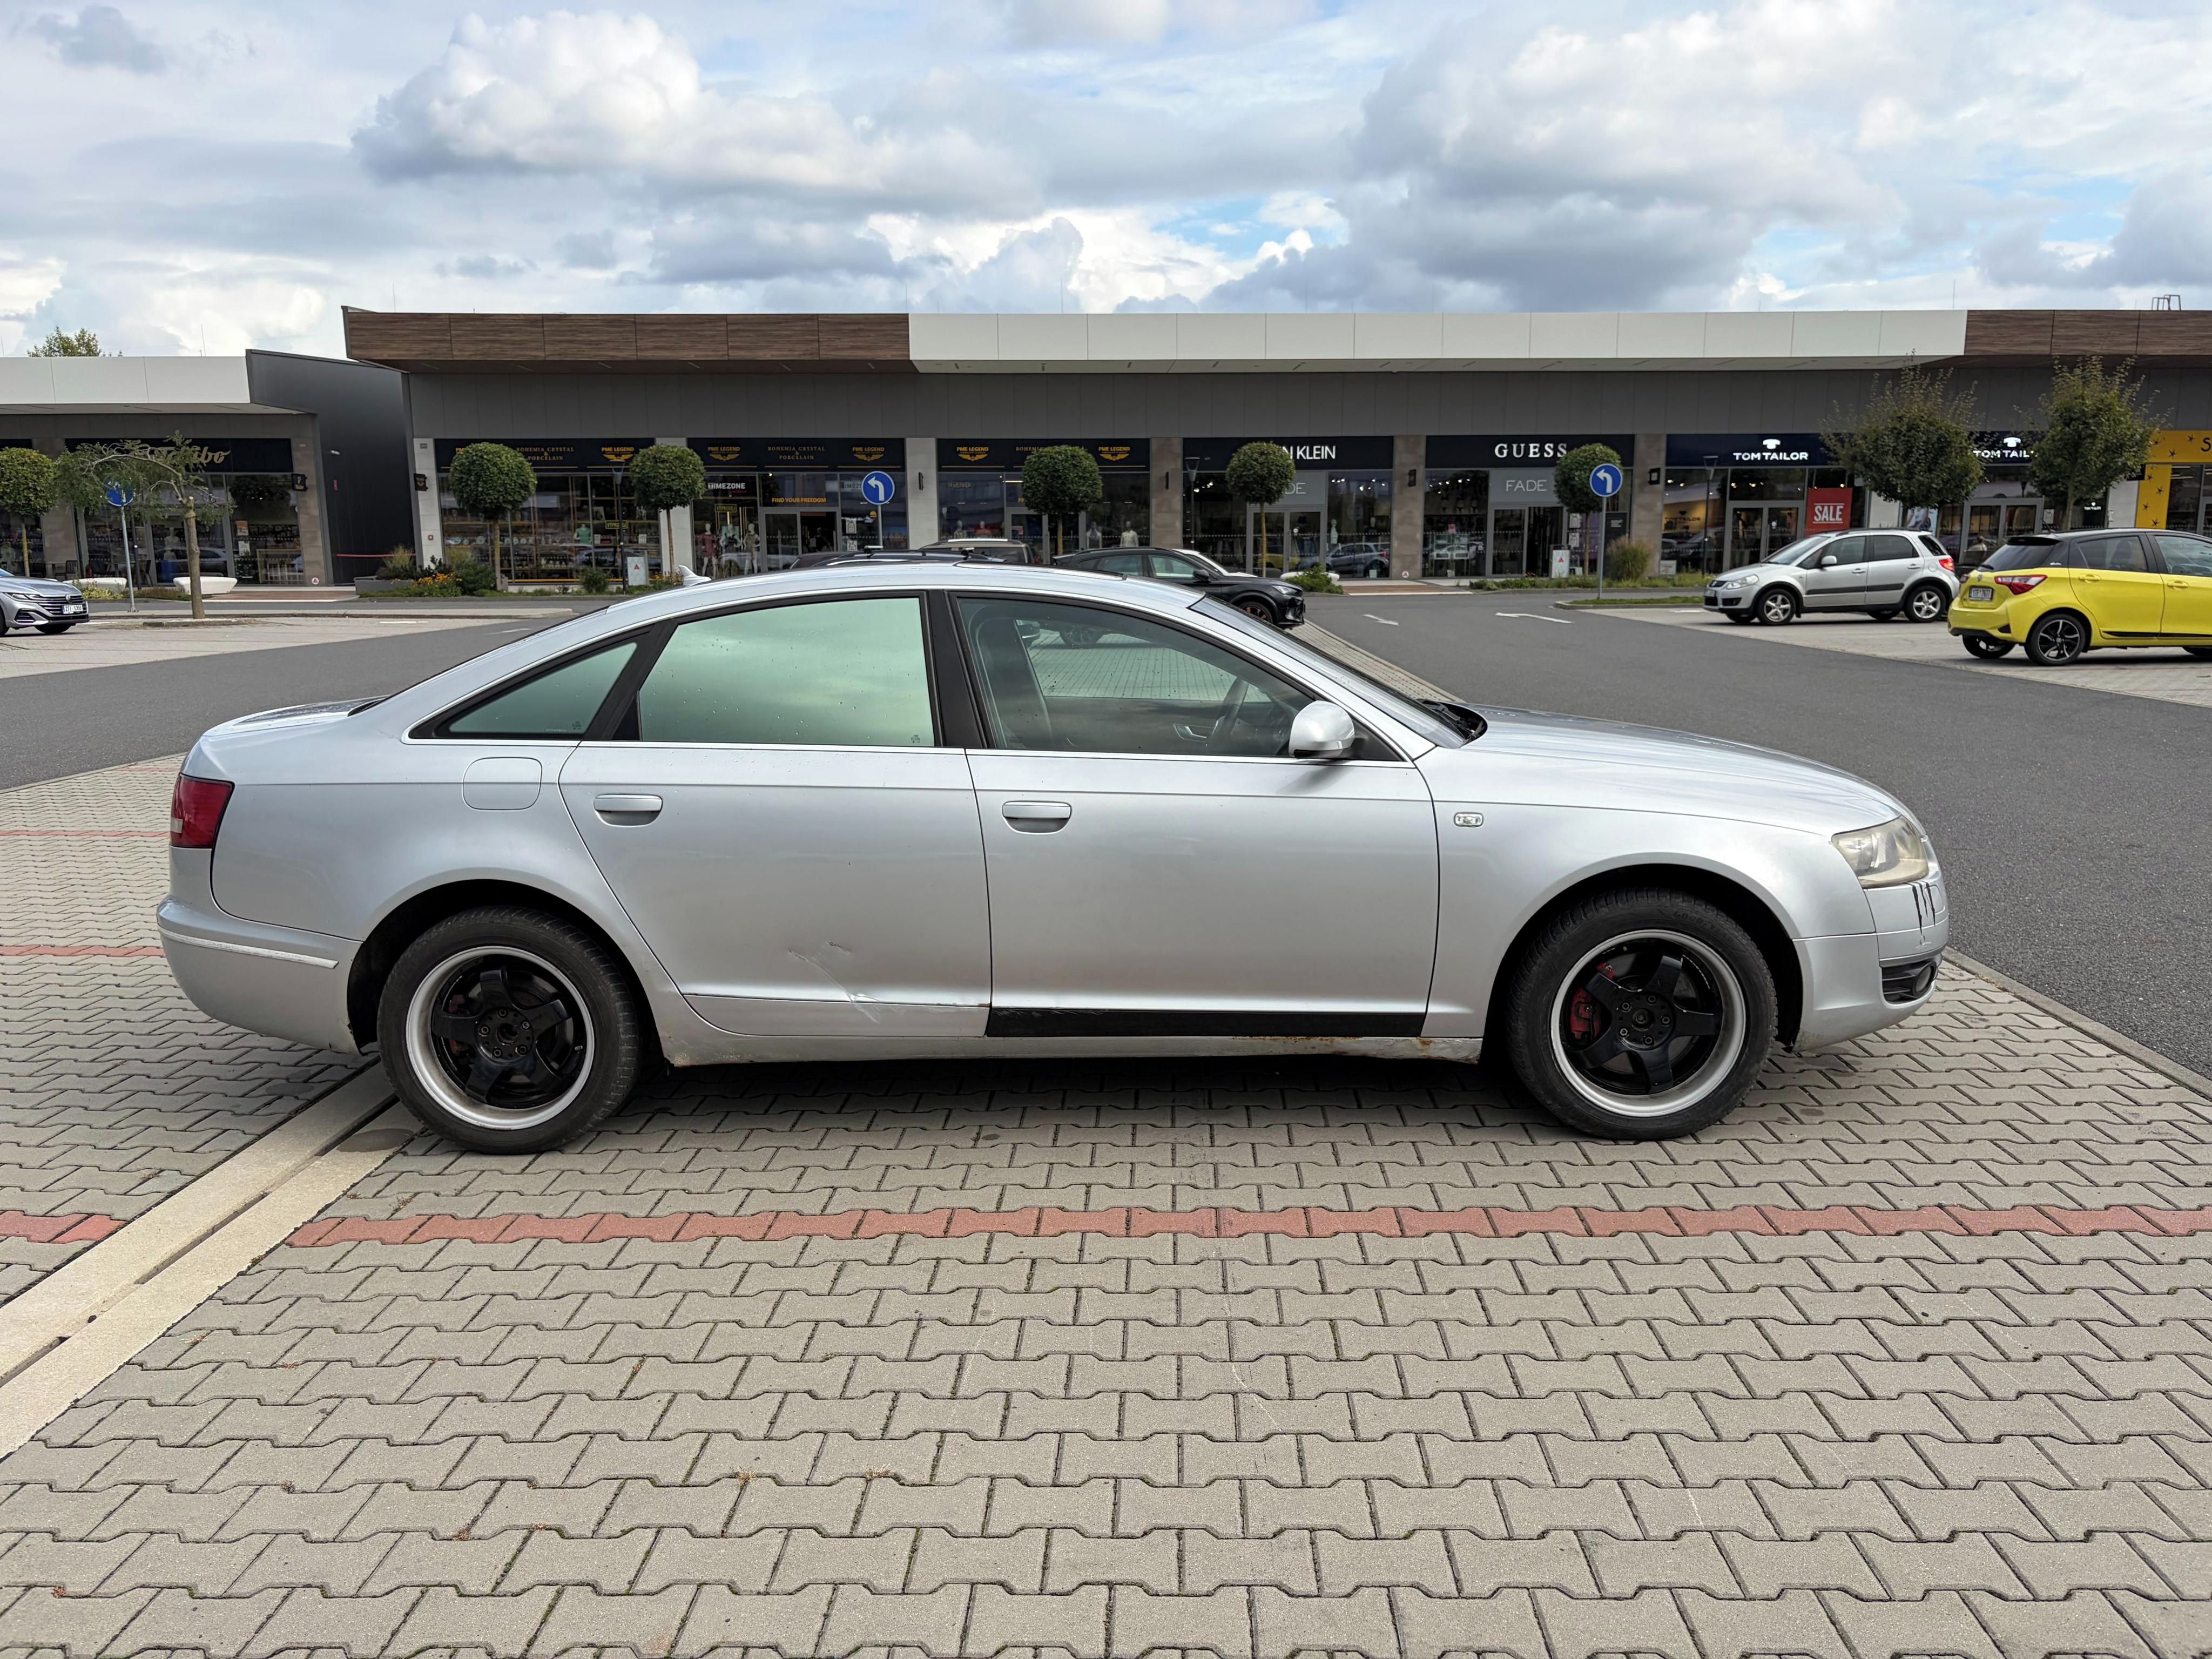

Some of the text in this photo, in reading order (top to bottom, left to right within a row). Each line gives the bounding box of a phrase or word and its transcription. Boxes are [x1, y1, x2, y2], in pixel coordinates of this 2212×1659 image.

[1297, 446, 1336, 460] KLEIN
[1494, 443, 1567, 458] GUESS
[1762, 452, 1809, 460] TAILOR
[1973, 450, 2039, 458] TOM TAIL
[1506, 480, 1547, 491] FADE
[1814, 505, 1844, 522] SALE
